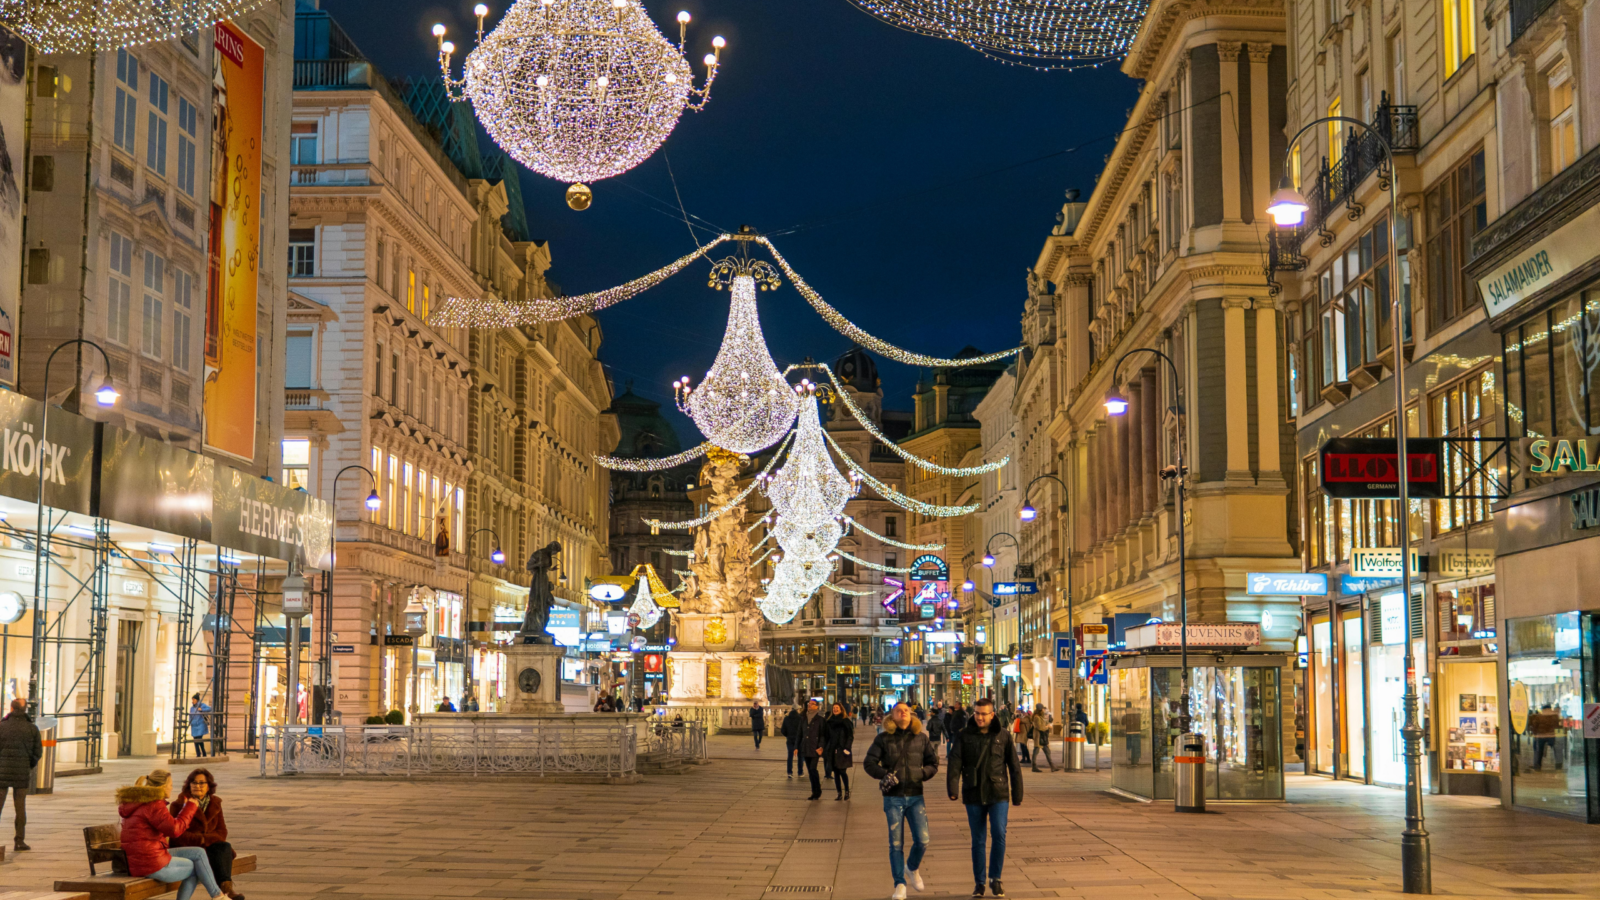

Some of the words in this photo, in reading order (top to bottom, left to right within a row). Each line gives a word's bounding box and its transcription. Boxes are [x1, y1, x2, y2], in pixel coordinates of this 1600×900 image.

[1488, 250, 1553, 306] SALAMANDER
[3, 421, 67, 486] KÖCK
[1530, 439, 1600, 473] SAL
[1330, 458, 1432, 478] LLOYD
[238, 496, 304, 547] HERMÈS
[998, 583, 1032, 593] Berlitz
[1273, 579, 1323, 592] Tchibo
[1174, 628, 1242, 638] SOUVENIRS
